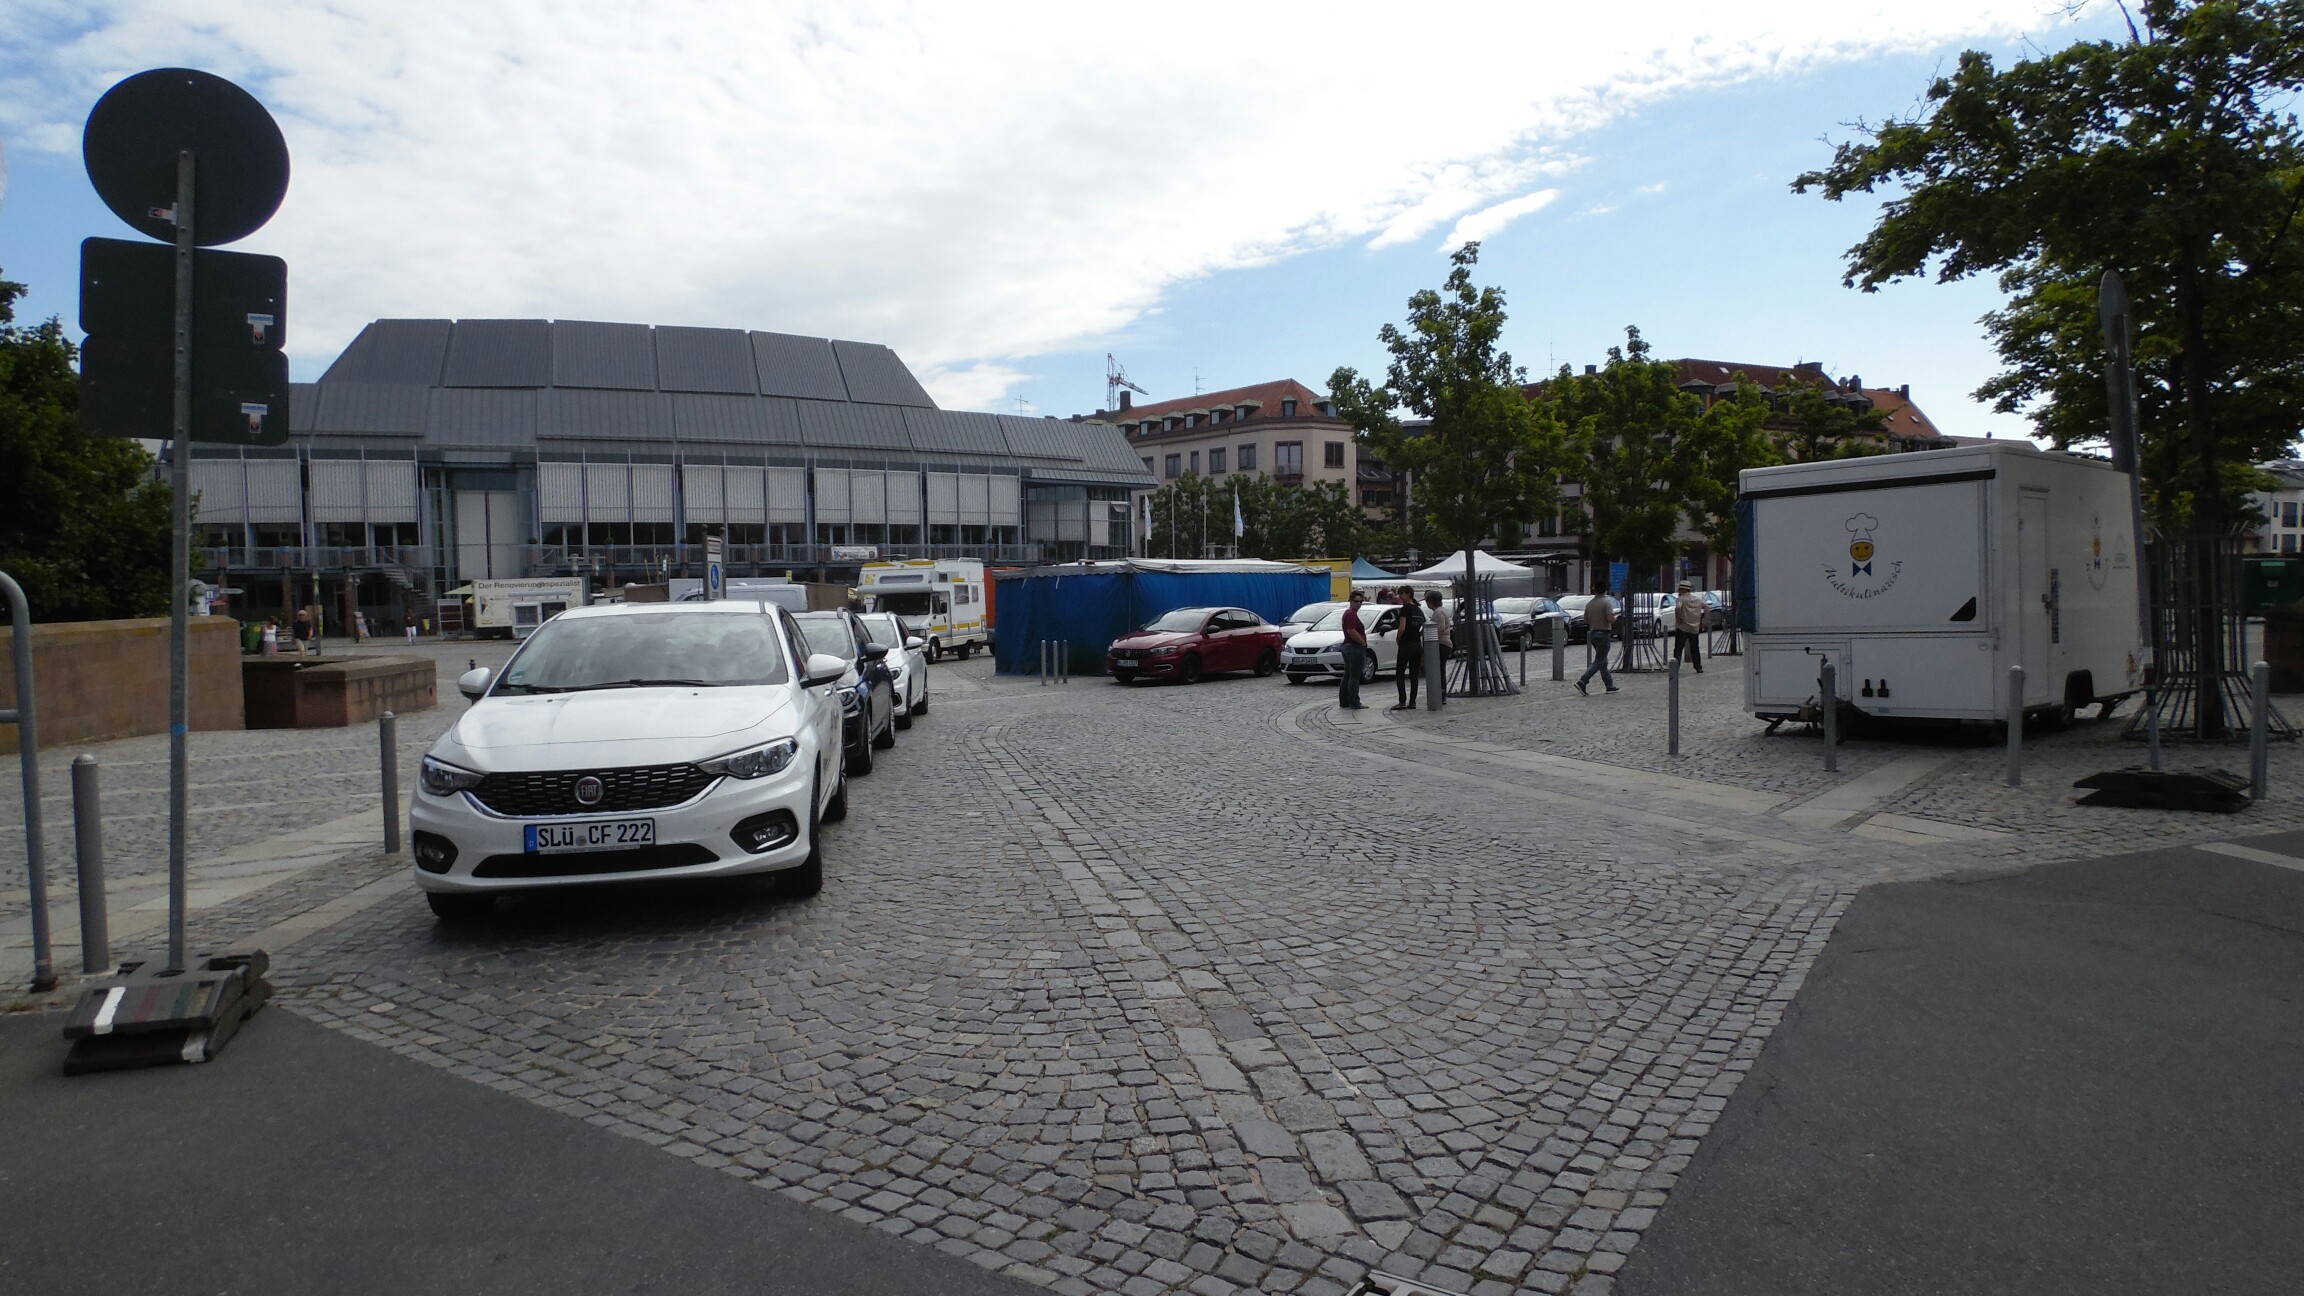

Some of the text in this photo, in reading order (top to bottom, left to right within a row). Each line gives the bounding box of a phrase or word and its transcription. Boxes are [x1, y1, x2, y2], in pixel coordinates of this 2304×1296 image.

[580, 784, 598, 798] FIAT
[588, 824, 612, 844] CF
[617, 822, 652, 843] 222
